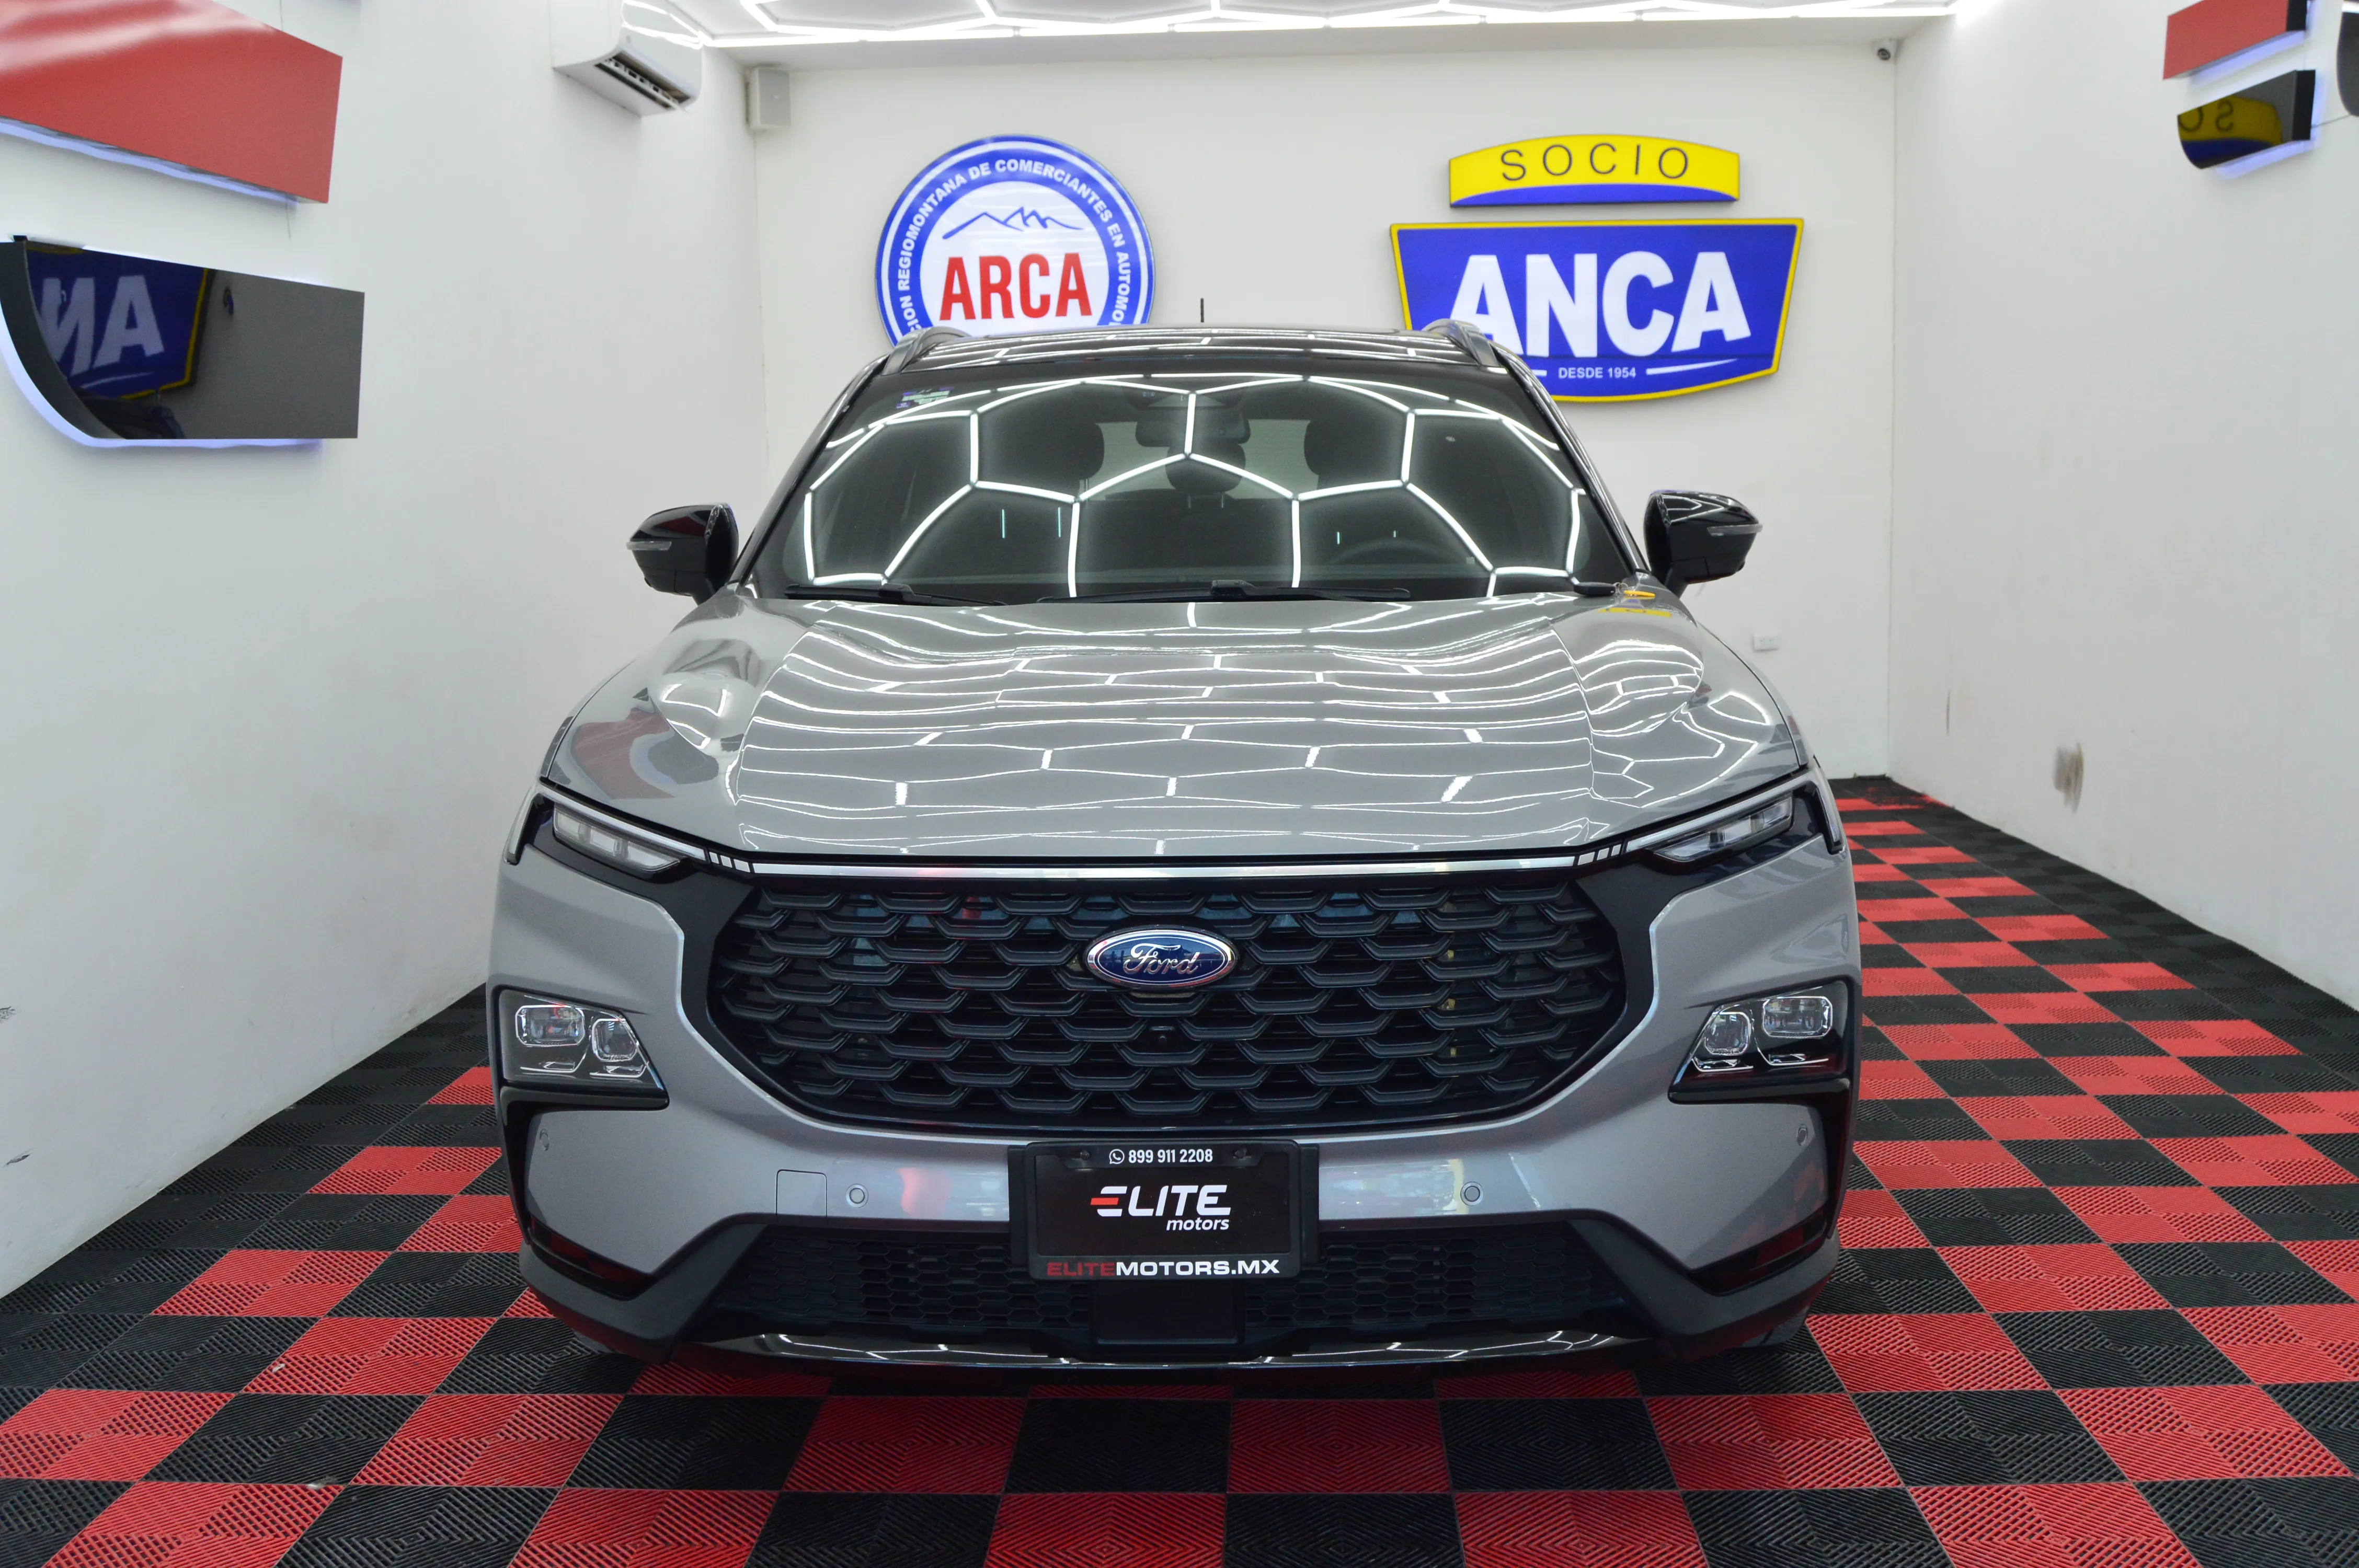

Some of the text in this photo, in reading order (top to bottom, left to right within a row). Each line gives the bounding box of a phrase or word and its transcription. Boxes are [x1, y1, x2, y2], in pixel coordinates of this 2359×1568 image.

[969, 162, 991, 179] DE
[1501, 143, 1688, 181] SOCIO
[995, 159, 1112, 223] COMERCIANTES
[898, 174, 966, 290] REGIOMONTANA
[1107, 224, 1125, 248] EN
[940, 253, 1092, 320] ARCA
[1109, 251, 1131, 326] AUTOMO
[1450, 251, 1751, 358] ANCA
[1558, 366, 1636, 379] DESDE 1954
[1124, 943, 1200, 974] Ford
[1128, 1149, 1213, 1163] 899 911 2208
[1091, 1185, 1231, 1217] ELITE
[1166, 1217, 1230, 1231] motors
[1047, 1260, 1279, 1276] ELITEMOTORS.MX
